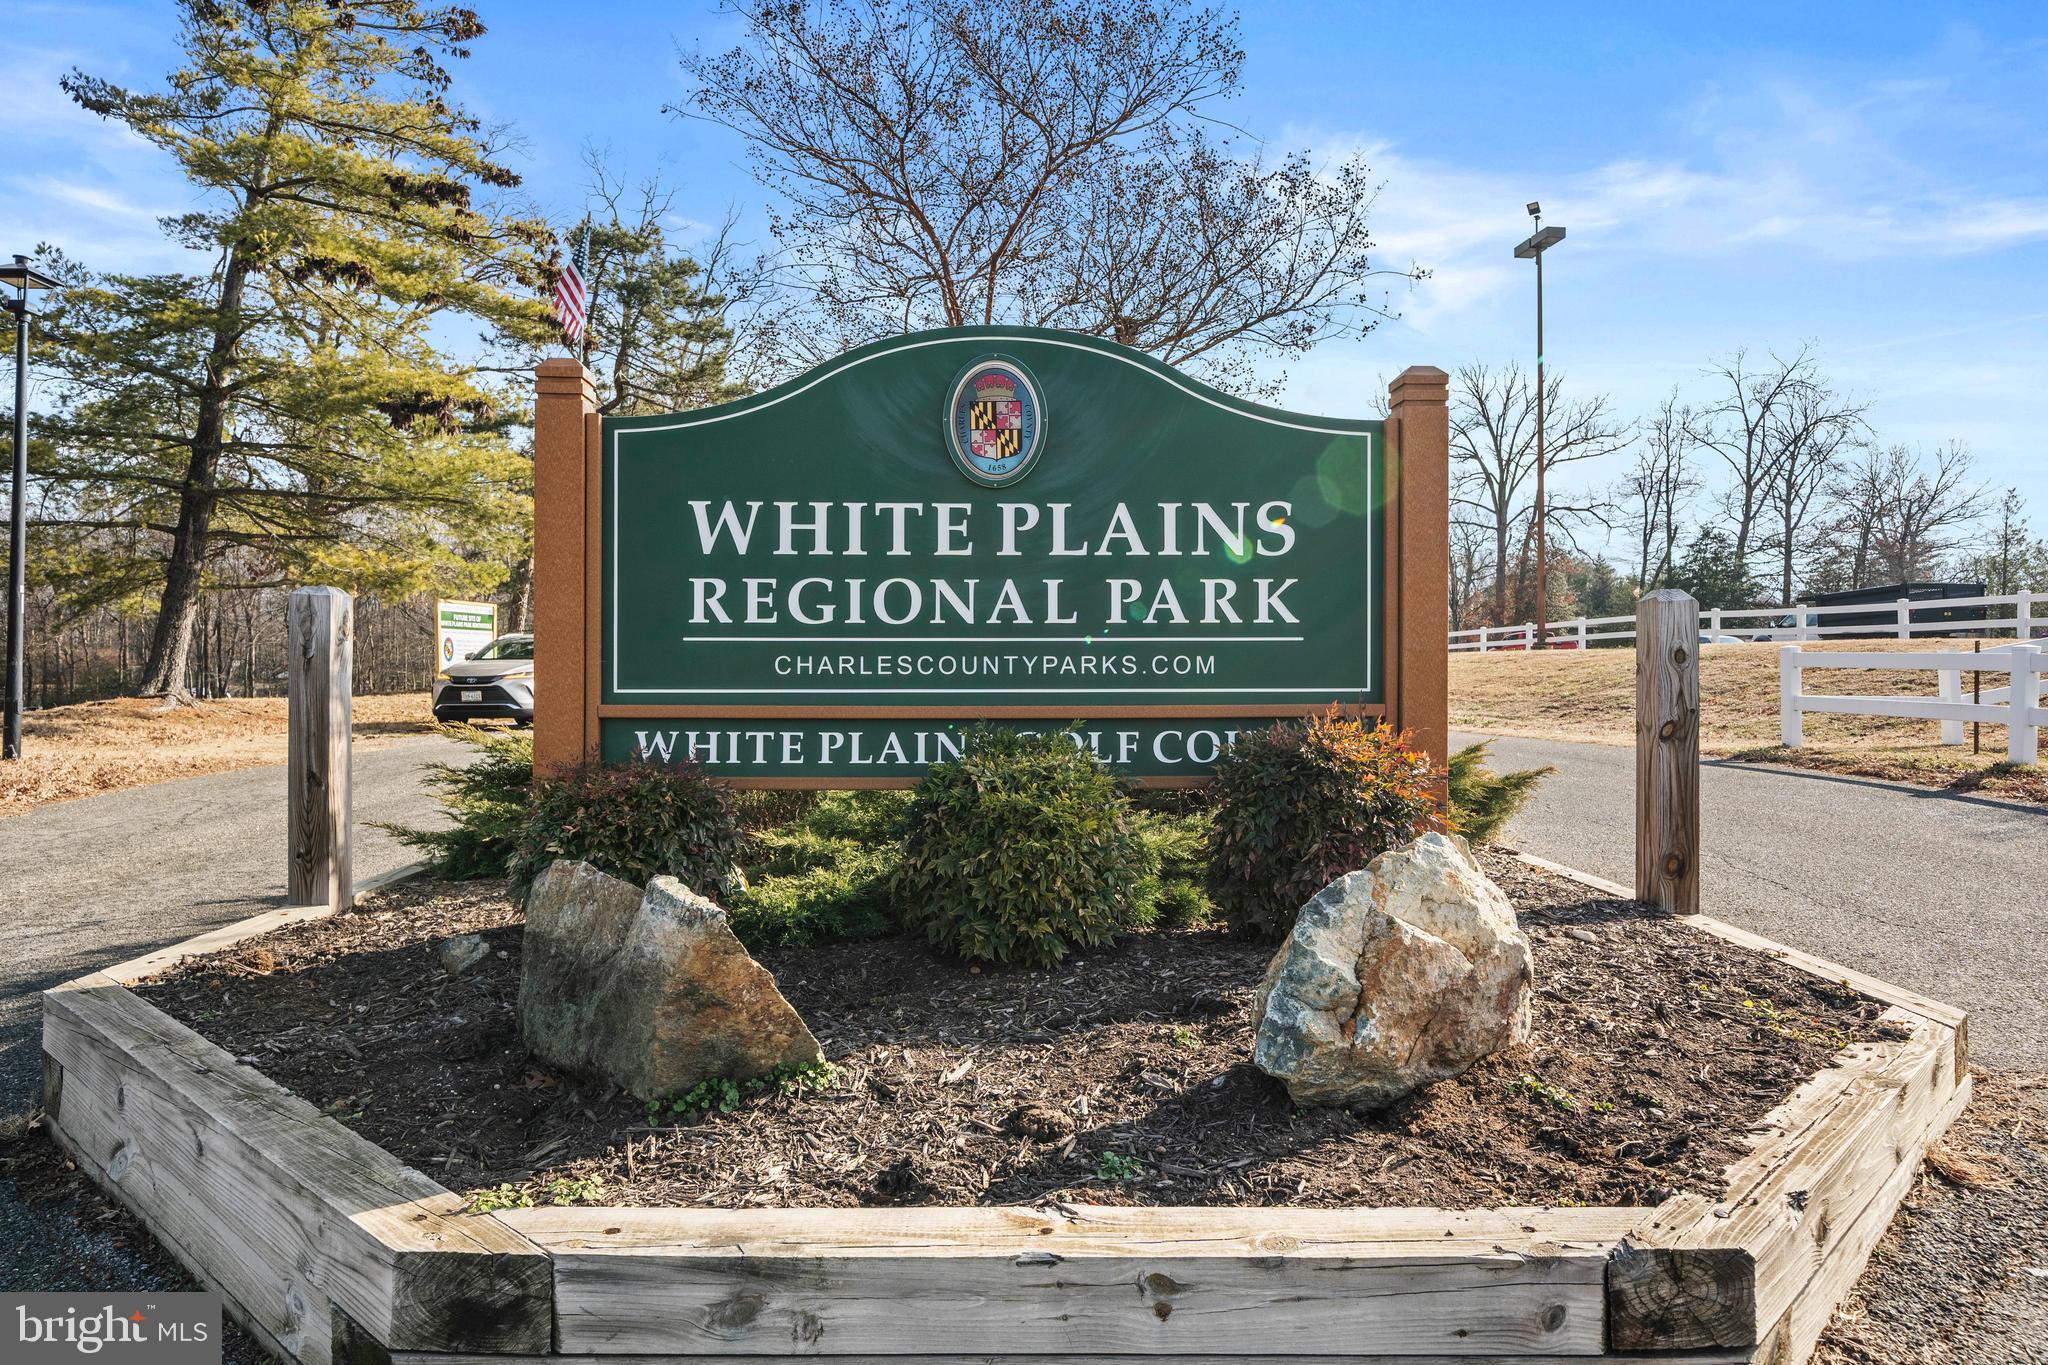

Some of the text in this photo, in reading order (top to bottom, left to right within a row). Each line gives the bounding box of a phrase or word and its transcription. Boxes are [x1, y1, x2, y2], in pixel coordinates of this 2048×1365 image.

[987, 463, 1007, 472] 1658
[687, 500, 1296, 557] WHITE PLAINS
[688, 577, 1300, 625] REGIONAL PARK
[774, 655, 1216, 676] CHARLESCOUNTYPARKS.COM
[634, 730, 804, 764] WHITE
[817, 731, 994, 764] PLAIN
